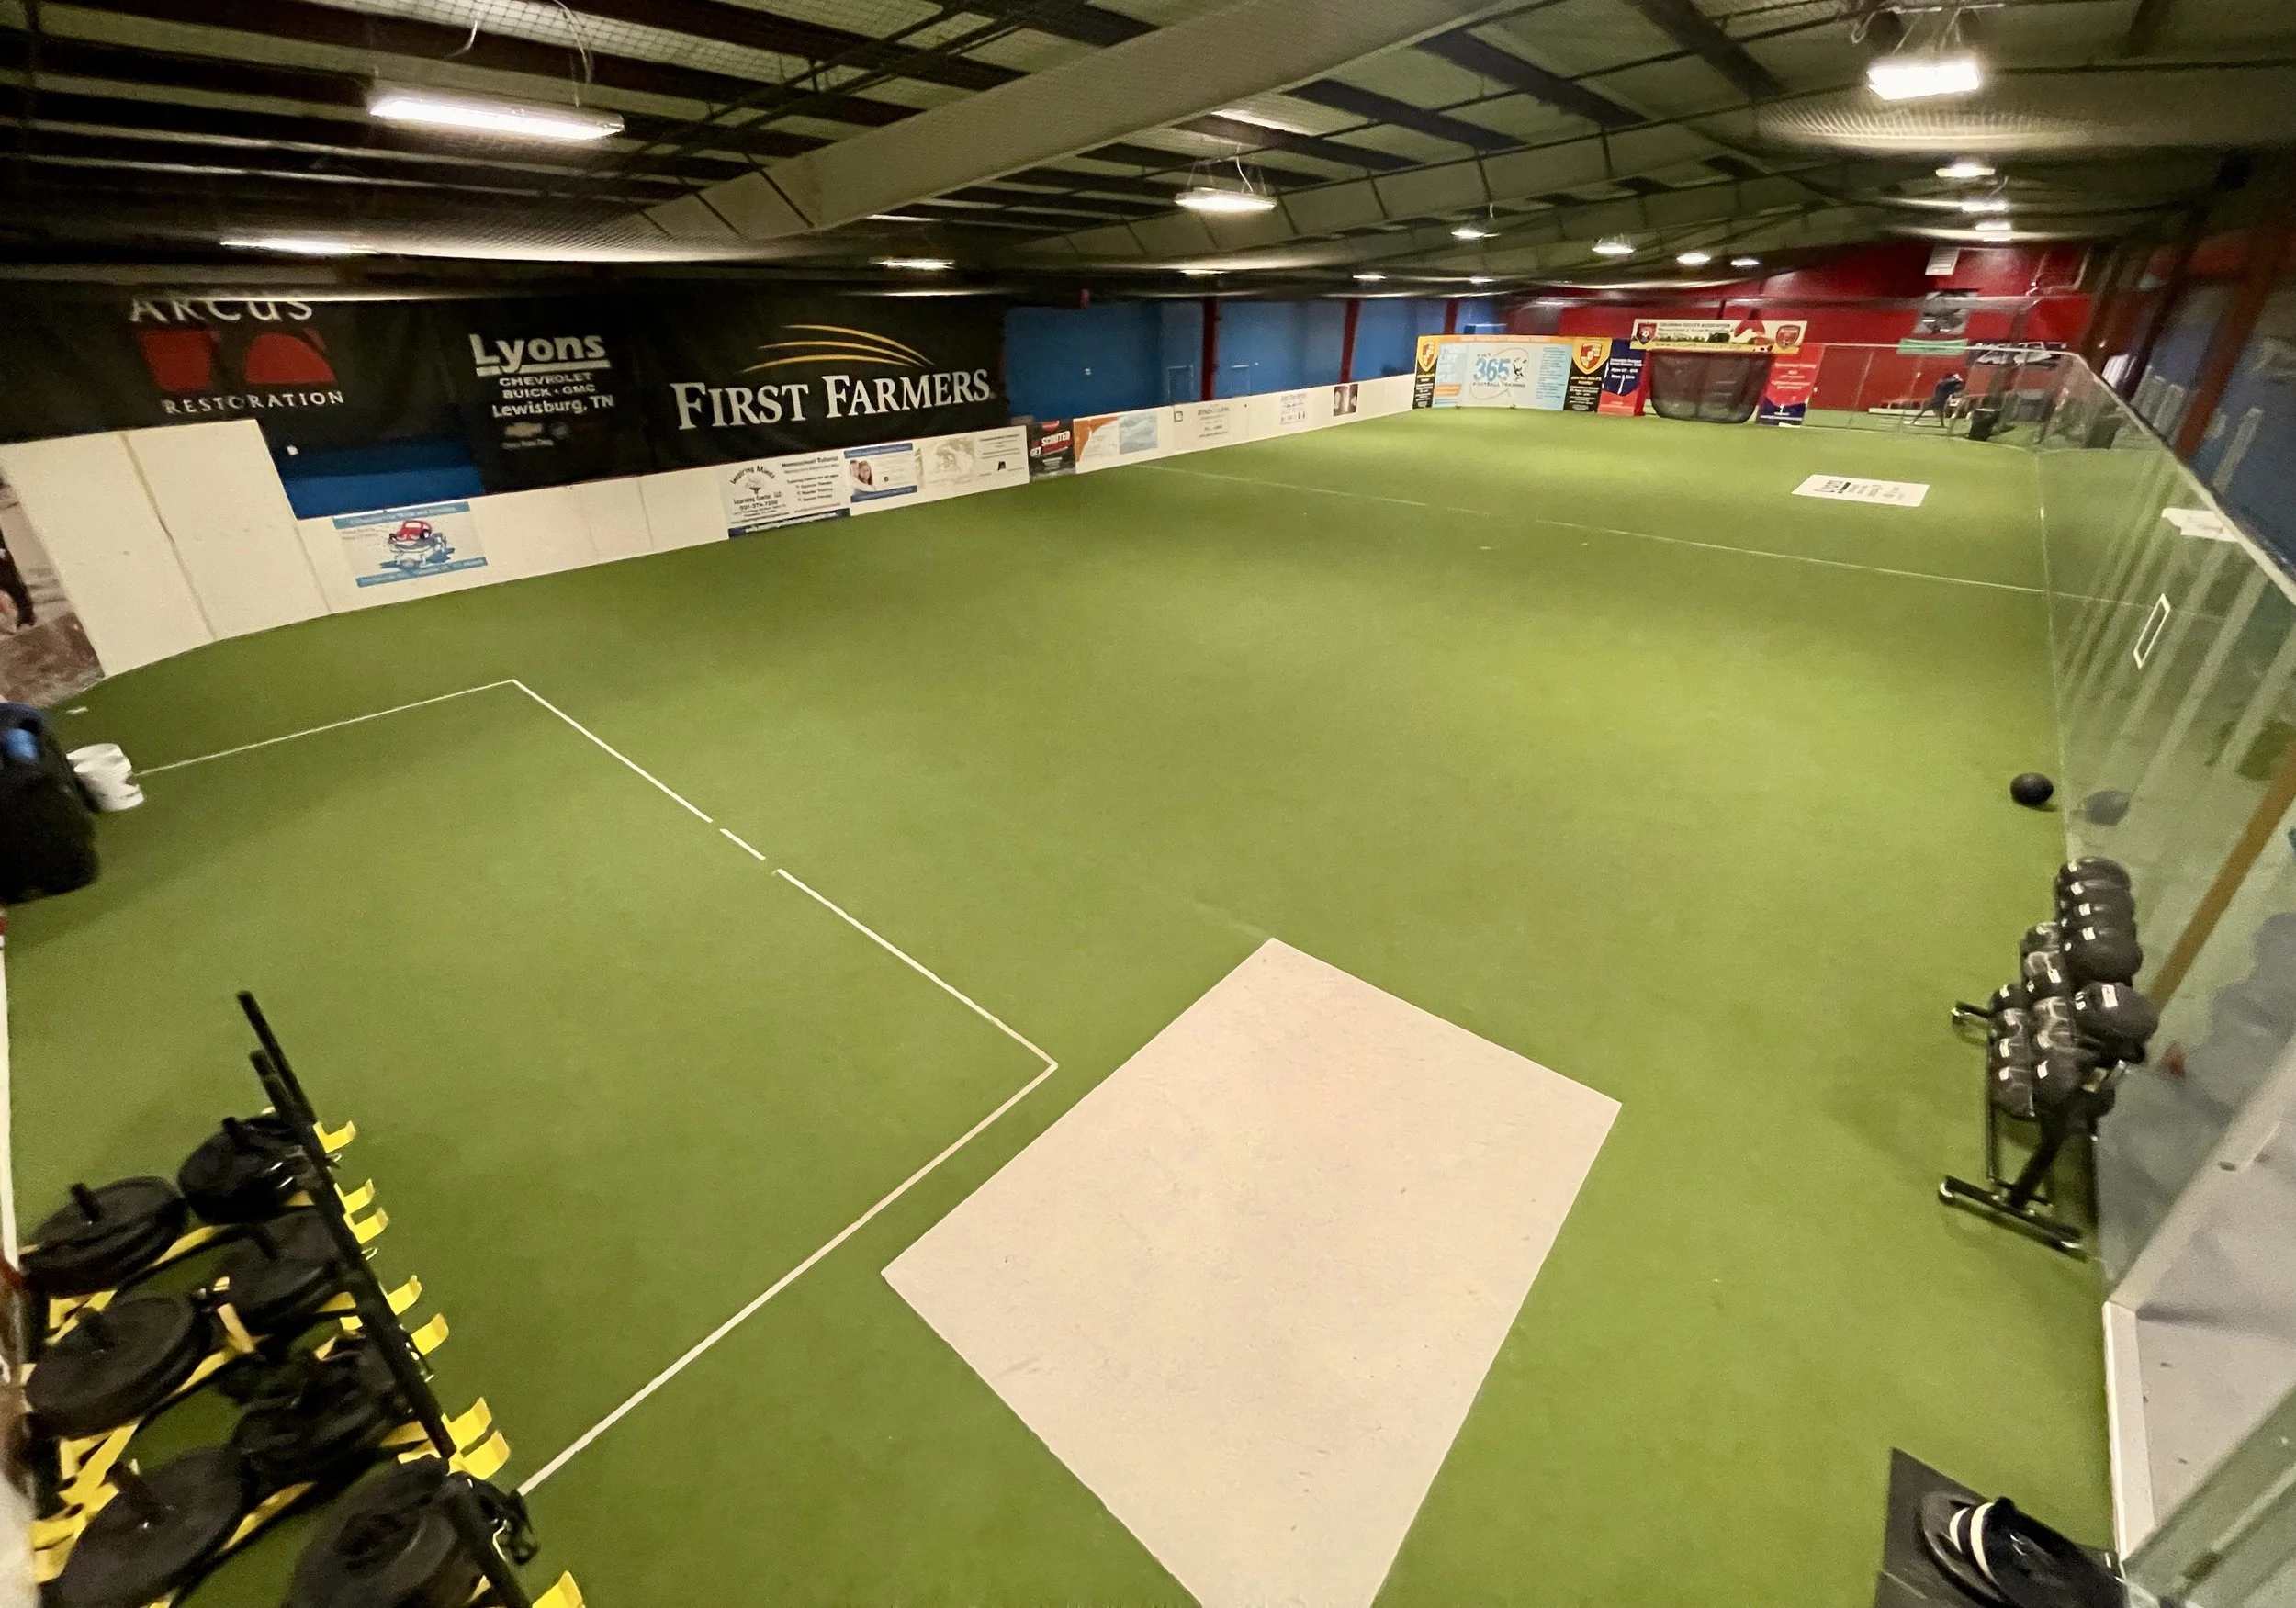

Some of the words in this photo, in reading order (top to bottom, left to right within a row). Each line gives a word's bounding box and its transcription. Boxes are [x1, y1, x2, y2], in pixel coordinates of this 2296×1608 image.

[469, 333, 606, 374] Lyons
[499, 372, 593, 387] CHEVROLET
[1473, 357, 1511, 382] 365
[162, 391, 344, 414] RESTORATION
[501, 388, 552, 399] BUICK
[562, 384, 596, 395] GMC
[670, 382, 809, 431] FIRST
[822, 368, 992, 419] FARMERS
[492, 399, 588, 418] Lewisburg,
[590, 394, 615, 409] TN
